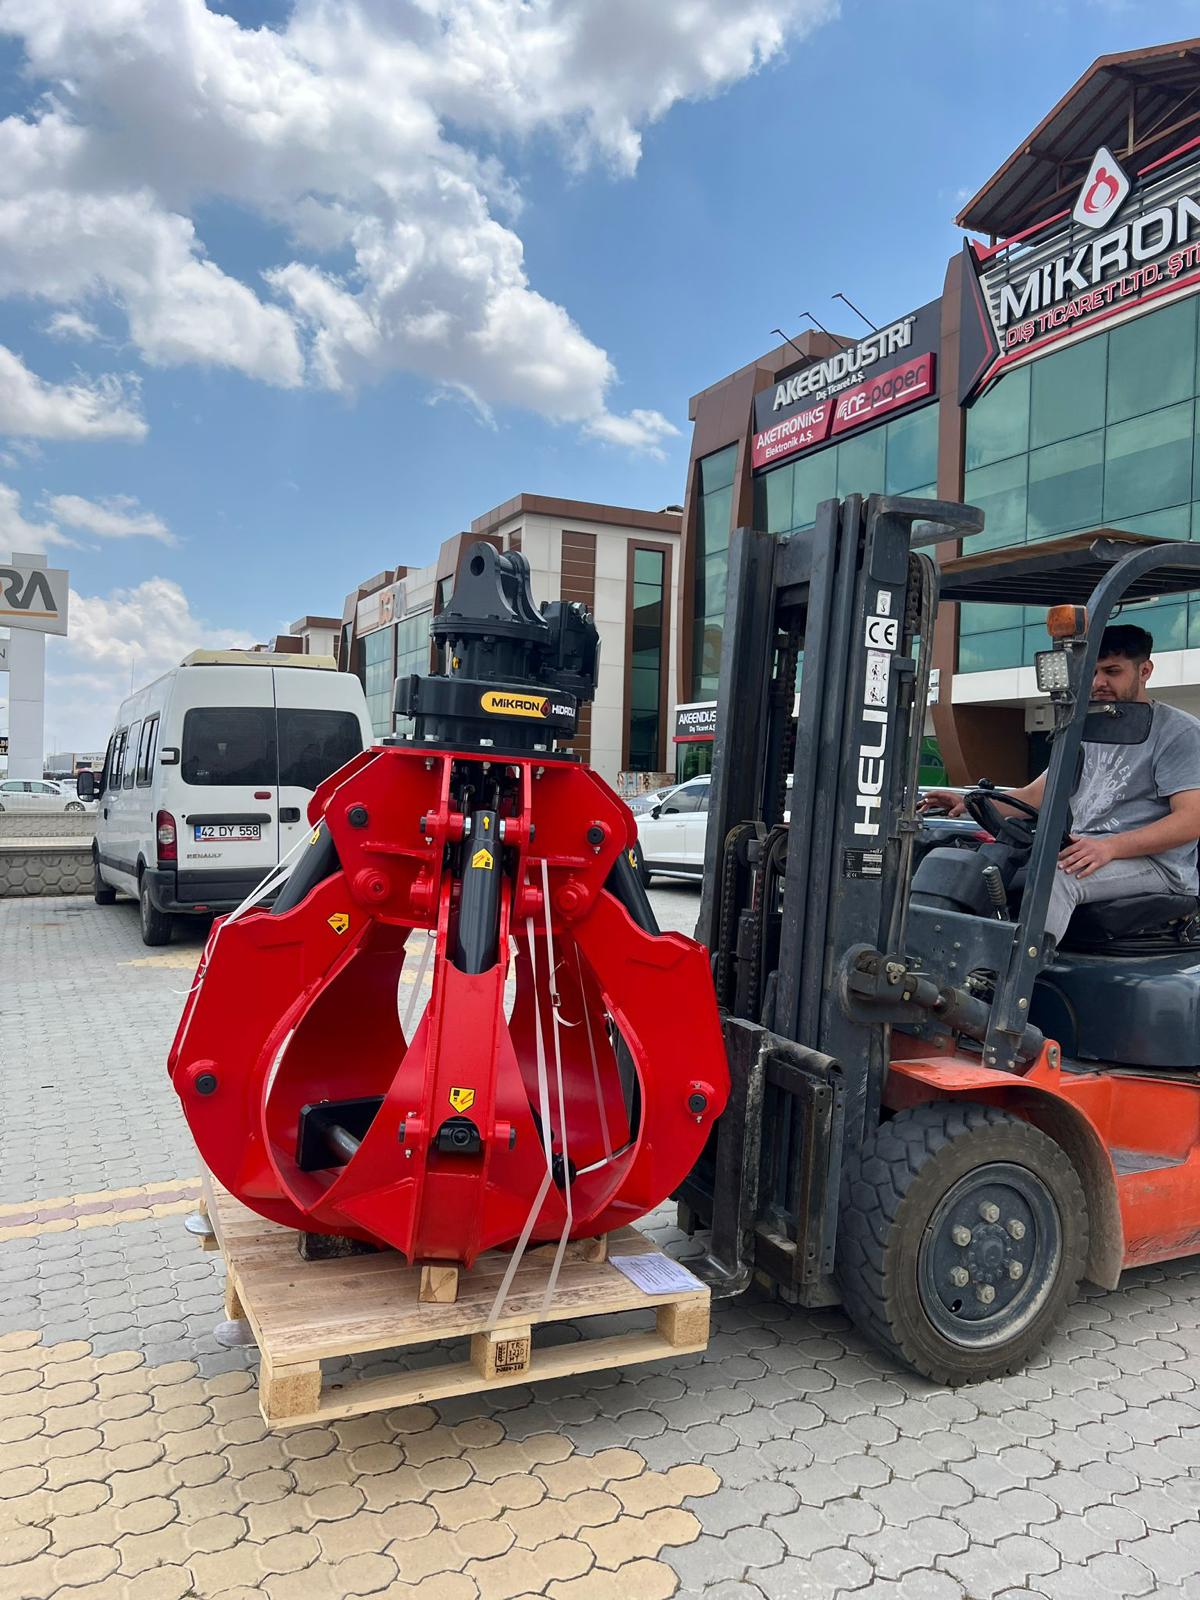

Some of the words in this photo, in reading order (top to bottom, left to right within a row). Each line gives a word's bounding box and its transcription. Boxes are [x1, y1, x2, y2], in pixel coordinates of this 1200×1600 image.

[1006, 320, 1035, 347] DIŞ
[1120, 263, 1163, 296] LTD.
[827, 378, 850, 395] Ticaret
[766, 436, 798, 458] Elektronik
[854, 709, 888, 836] HELI
[201, 826, 215, 837] 42
[219, 826, 234, 837] DY
[239, 825, 259, 836] 558
